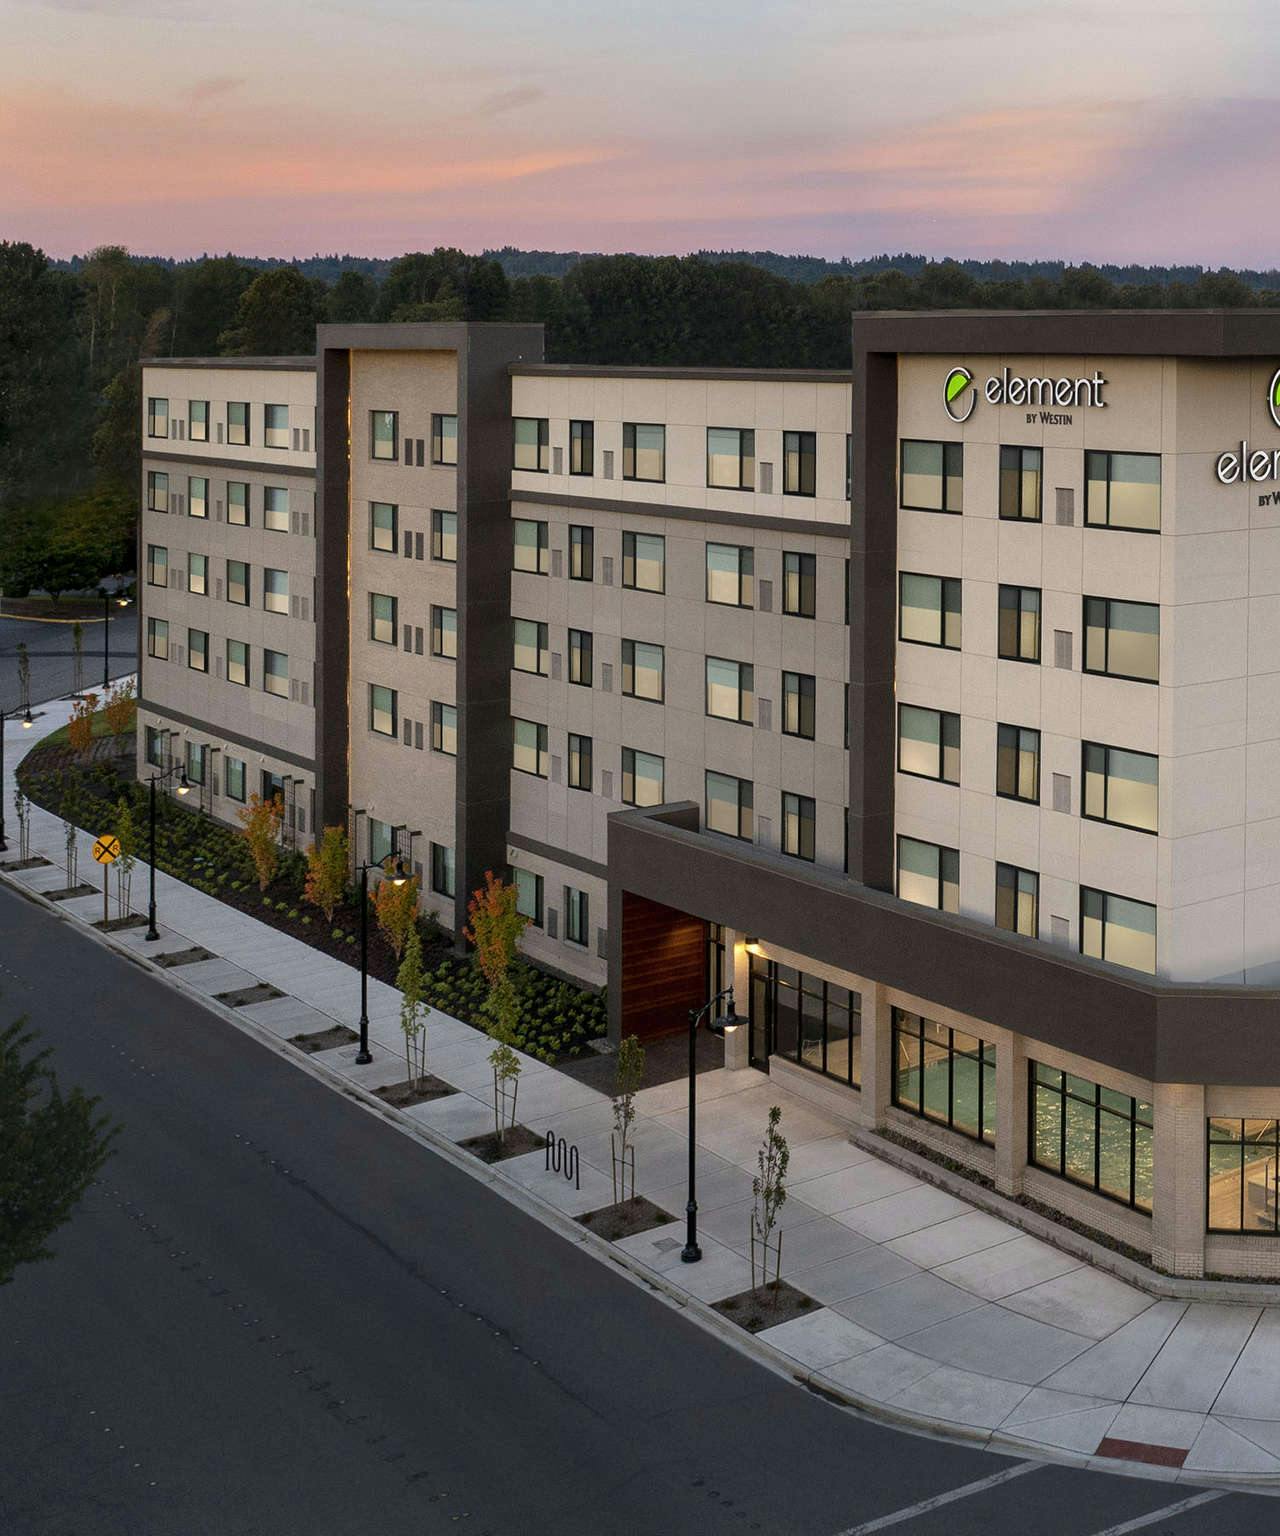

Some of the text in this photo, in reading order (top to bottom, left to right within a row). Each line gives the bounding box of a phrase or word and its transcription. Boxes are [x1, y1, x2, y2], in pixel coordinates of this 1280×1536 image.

[985, 367, 1106, 408] element
[1026, 413, 1037, 424] BY
[1258, 495, 1271, 506] BY
